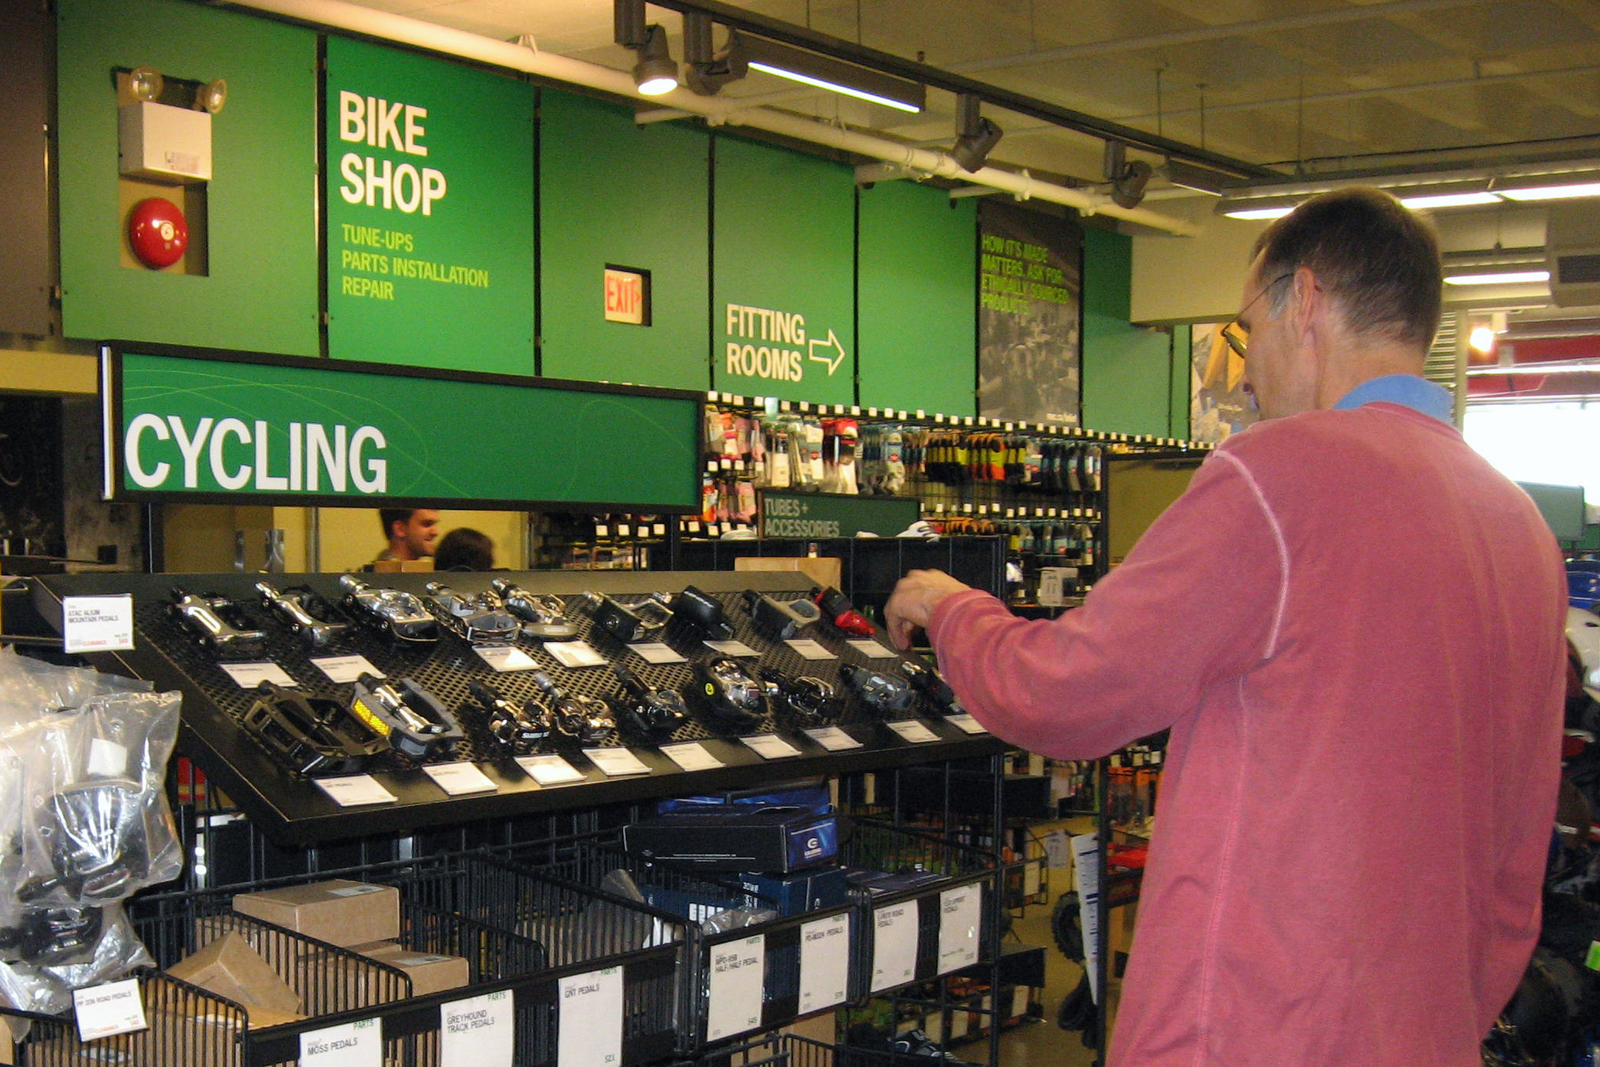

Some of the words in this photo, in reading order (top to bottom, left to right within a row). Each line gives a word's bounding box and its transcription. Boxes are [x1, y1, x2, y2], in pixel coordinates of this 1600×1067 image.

[340, 90, 428, 156] BIKE
[340, 152, 447, 216] SHOP
[341, 223, 414, 253] TUNE-UPS
[341, 249, 389, 275] PARTS
[393, 257, 489, 288] INSTALLATION
[342, 275, 394, 301] REPAIR
[606, 275, 638, 314] EXIT
[727, 303, 805, 346] FITTING
[727, 342, 803, 382] ROOMS
[124, 413, 388, 494] CYCLING
[764, 498, 800, 517] TUBES
[765, 519, 840, 538] ACCESSORIES
[487, 992, 507, 1002] PARTS
[577, 983, 600, 995] PEDALS
[446, 1009, 488, 1025] GREYHOUND
[470, 1016, 495, 1029] PEDALS
[307, 1043, 329, 1056] MOSS
[330, 1037, 358, 1051] PEDALS
